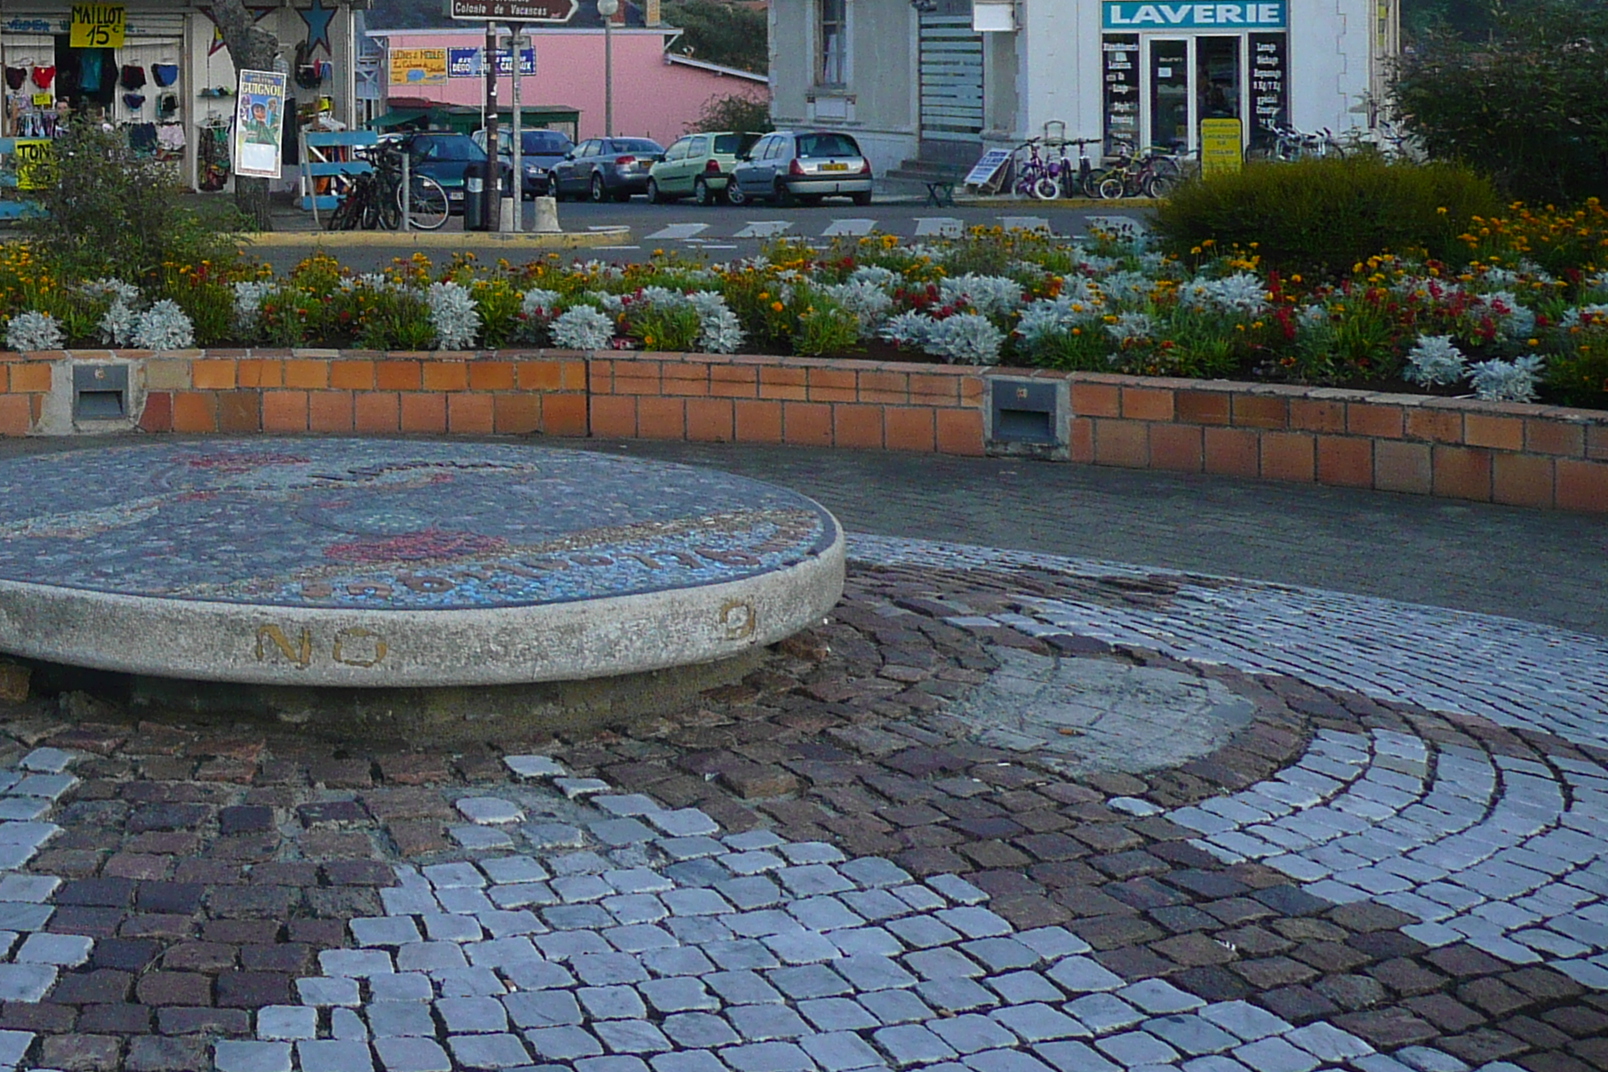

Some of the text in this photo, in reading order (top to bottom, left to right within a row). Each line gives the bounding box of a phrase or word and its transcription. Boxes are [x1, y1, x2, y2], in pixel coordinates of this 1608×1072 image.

[72, 5, 124, 24] MAILLOT
[455, 2, 547, 16] Colonie de Vacances
[1110, 3, 1280, 25] LAVERIE
